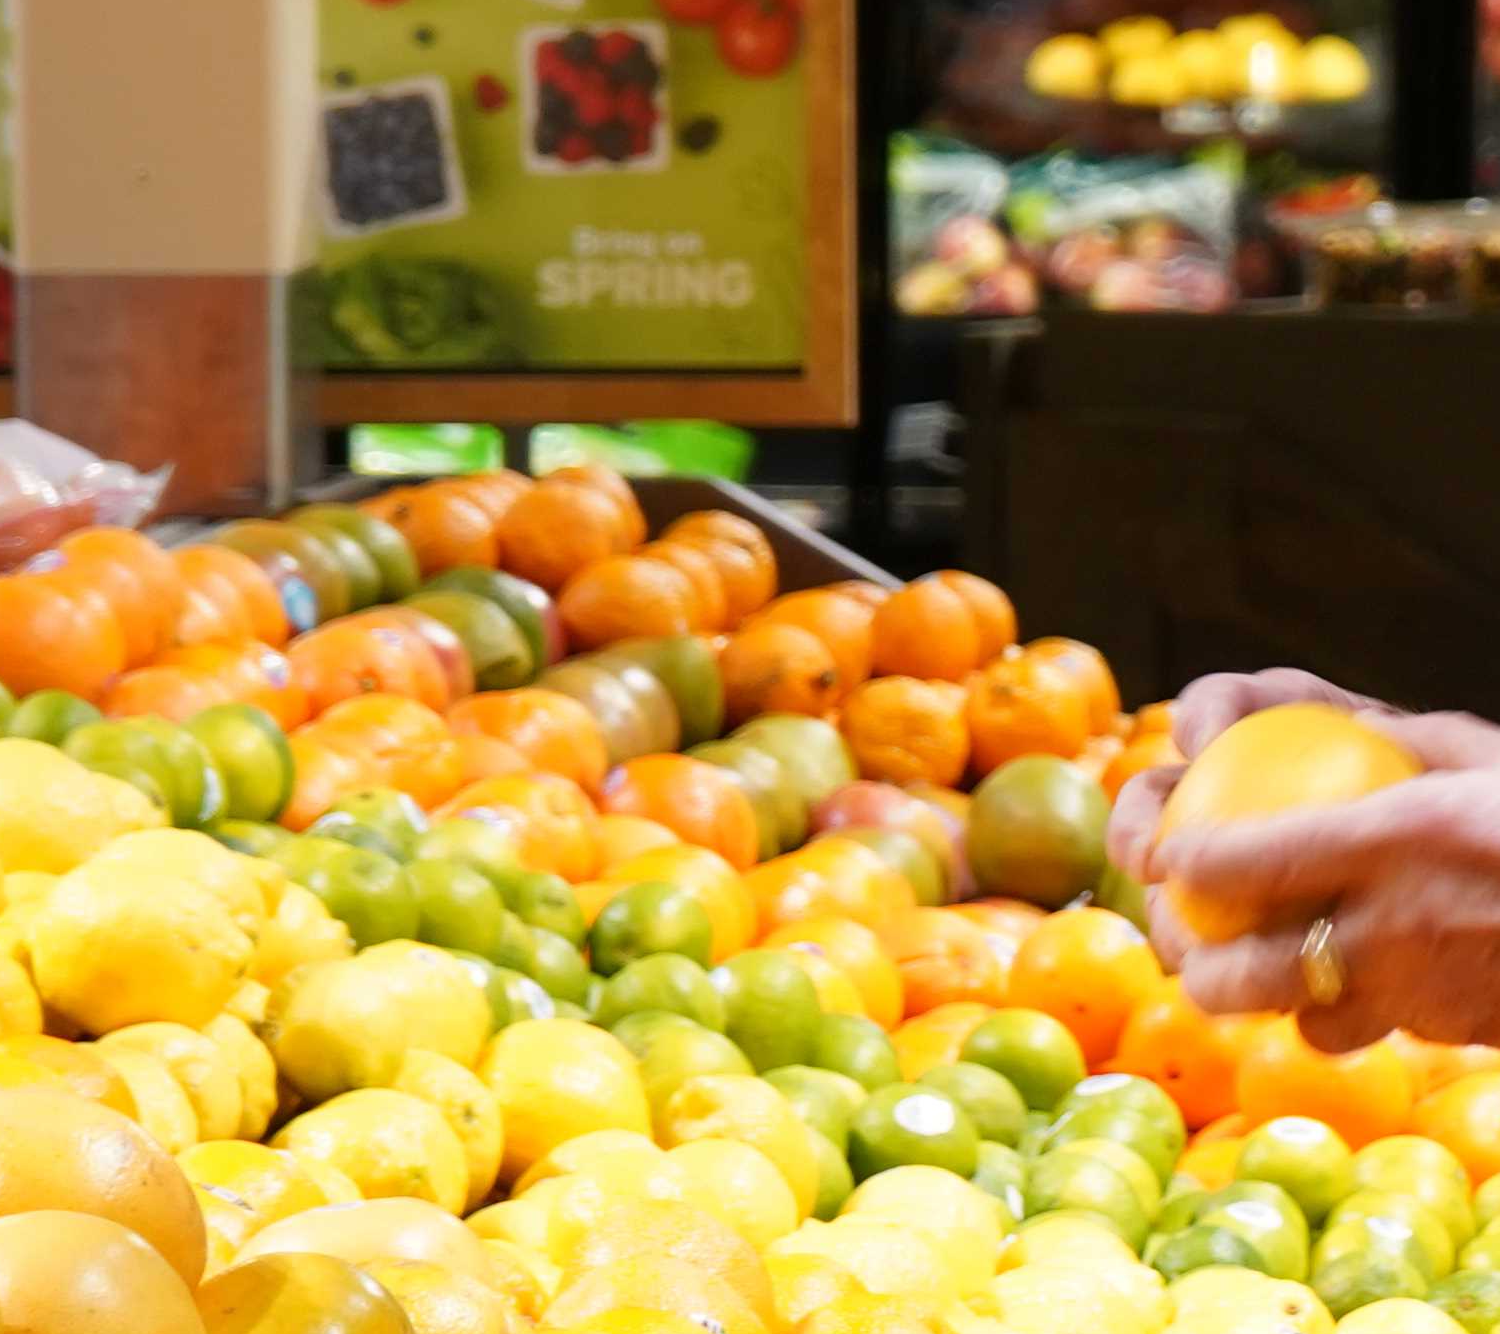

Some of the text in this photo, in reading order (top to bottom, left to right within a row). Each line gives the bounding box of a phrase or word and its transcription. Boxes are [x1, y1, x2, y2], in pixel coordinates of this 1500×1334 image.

[572, 226, 704, 258] Bring on
[535, 258, 754, 308] SPRING
